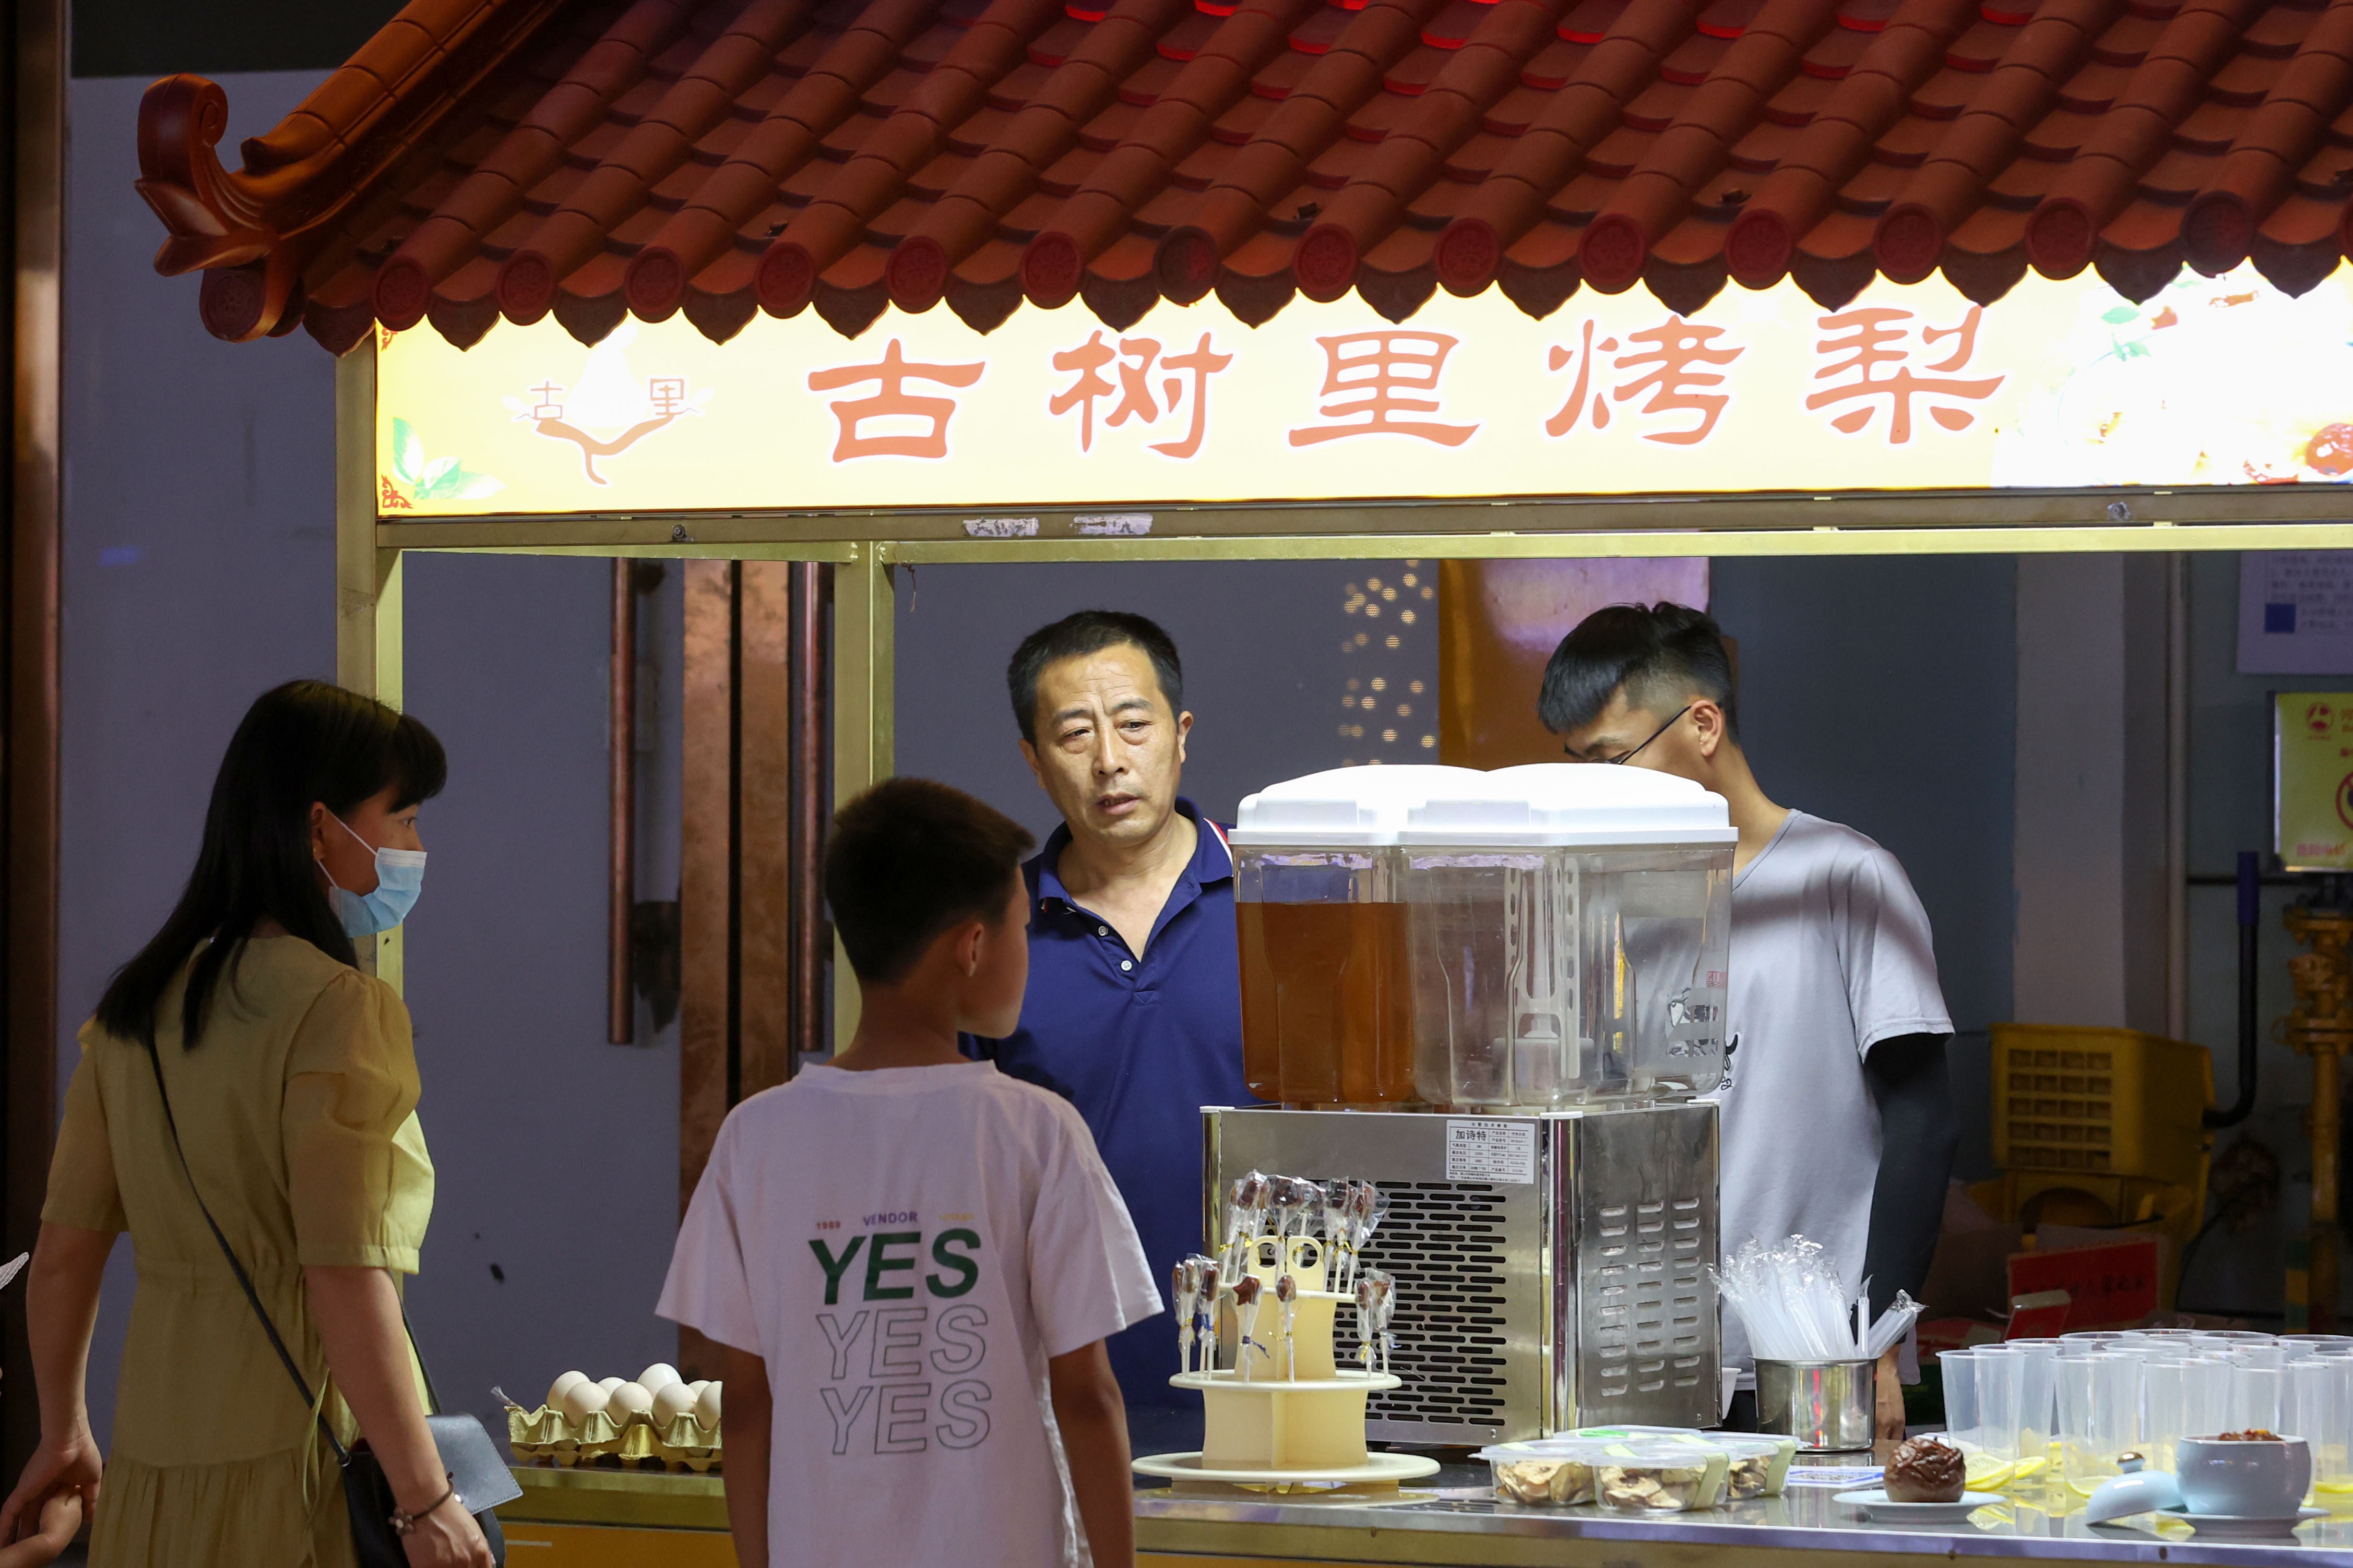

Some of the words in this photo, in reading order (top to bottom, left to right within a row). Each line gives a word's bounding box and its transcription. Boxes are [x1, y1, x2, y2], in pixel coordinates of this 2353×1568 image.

[530, 380, 563, 420] 古
[650, 378, 684, 416] 里
[808, 306, 2005, 463] 古树里烤梨
[1455, 1129, 1487, 1141] 加诗特
[862, 1211, 918, 1227] VENDOR
[808, 1228, 981, 1305] YES
[815, 1304, 988, 1380] YES
[819, 1379, 992, 1455] YES
